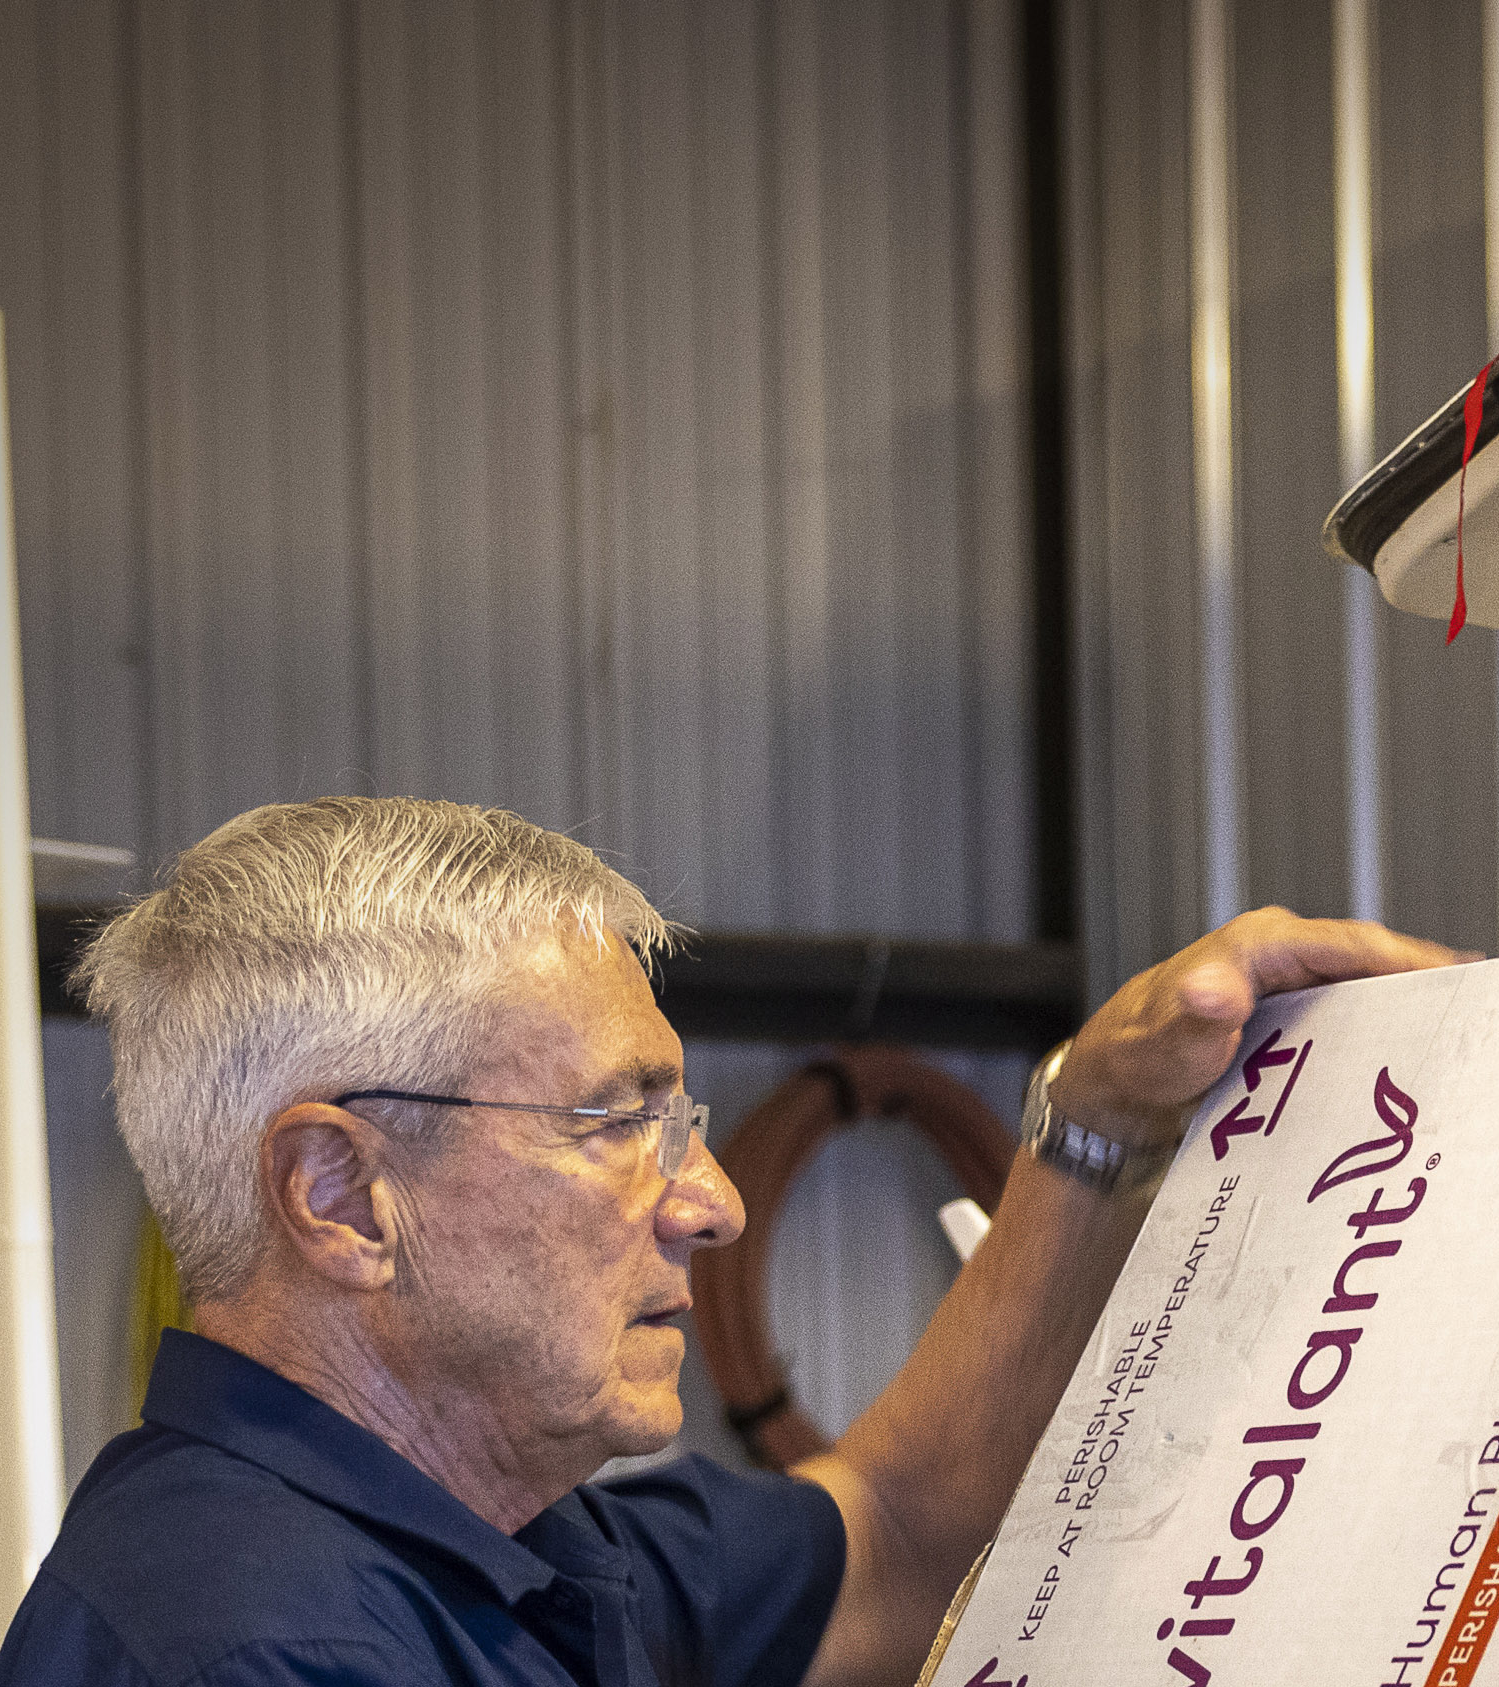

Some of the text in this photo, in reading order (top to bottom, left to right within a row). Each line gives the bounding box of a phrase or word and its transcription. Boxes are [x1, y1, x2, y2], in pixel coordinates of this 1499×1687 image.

[1018, 1175, 1240, 1641] KEEP AT ROOM TEMPERATURE
[1055, 1320, 1150, 1504] PERISHABLE
